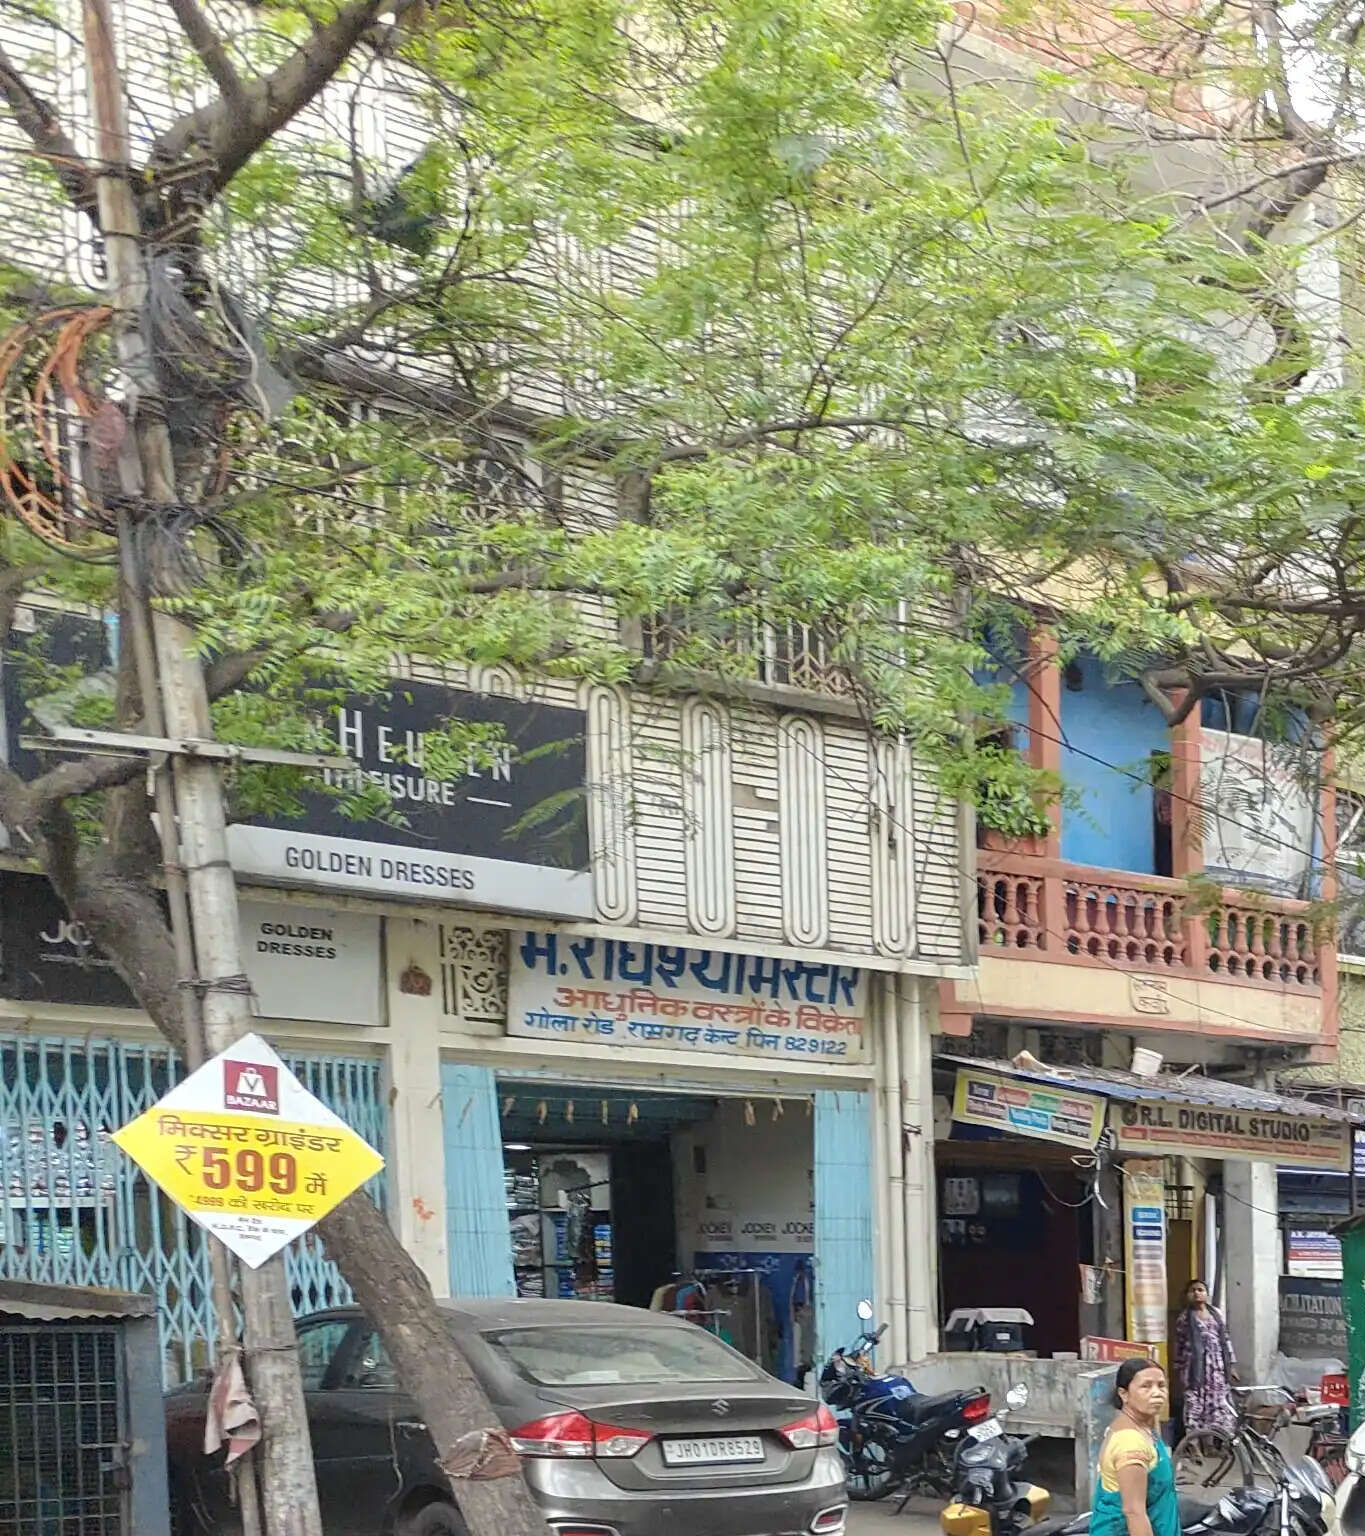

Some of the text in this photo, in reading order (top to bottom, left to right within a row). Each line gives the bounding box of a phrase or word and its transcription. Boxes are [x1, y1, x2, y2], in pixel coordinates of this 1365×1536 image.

[285, 846, 475, 890] GOLDEN DRESSES
[260, 921, 333, 941] GOLDEN
[256, 939, 337, 960] DRESSES
[553, 986, 689, 1022] आधुनिक
[524, 1008, 577, 1033] गोला
[582, 1011, 615, 1035] रोड
[745, 1026, 778, 1051] पिन
[784, 1037, 848, 1057] 829122
[225, 1094, 278, 1111] BAZAAR
[158, 1113, 343, 1153] मिक्सर ग्राइंडर
[1178, 1109, 1244, 1135] DIGITAL
[1249, 1117, 1310, 1142] STUDIO
[304, 1171, 328, 1197] में
[782, 1221, 815, 1235] JOCKE
